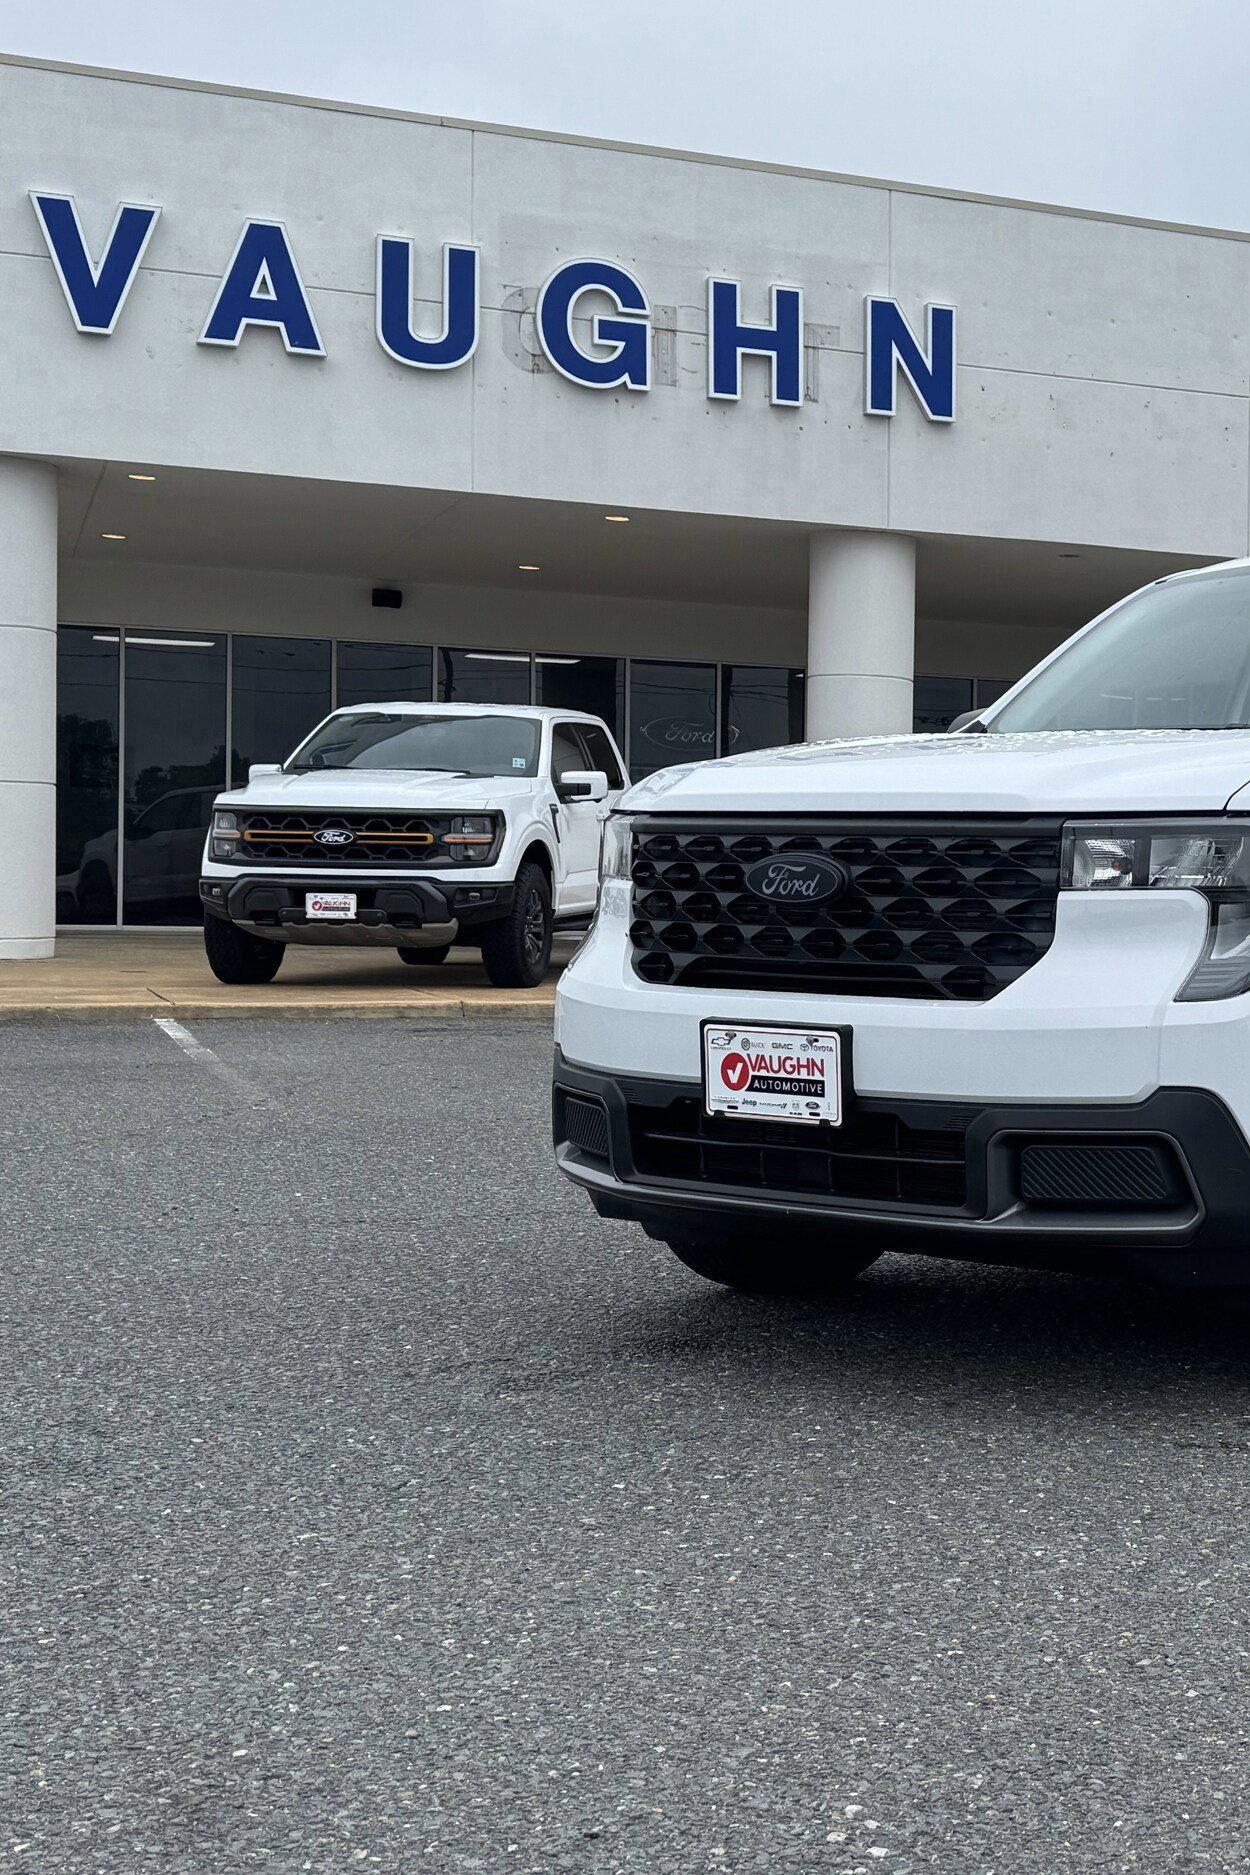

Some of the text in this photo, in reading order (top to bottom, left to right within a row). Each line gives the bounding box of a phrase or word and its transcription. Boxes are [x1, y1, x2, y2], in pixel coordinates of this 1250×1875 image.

[29, 190, 957, 424] VAUGHN
[664, 720, 715, 743] Ford
[321, 832, 346, 842] Ford
[762, 863, 820, 896] Ford
[771, 1042, 793, 1050] GMC
[810, 1044, 834, 1052] TOYOTA
[747, 1053, 825, 1078] VAUGHN
[753, 1079, 823, 1094] AUTOMOTIVE
[741, 1098, 757, 1107] Jeep
